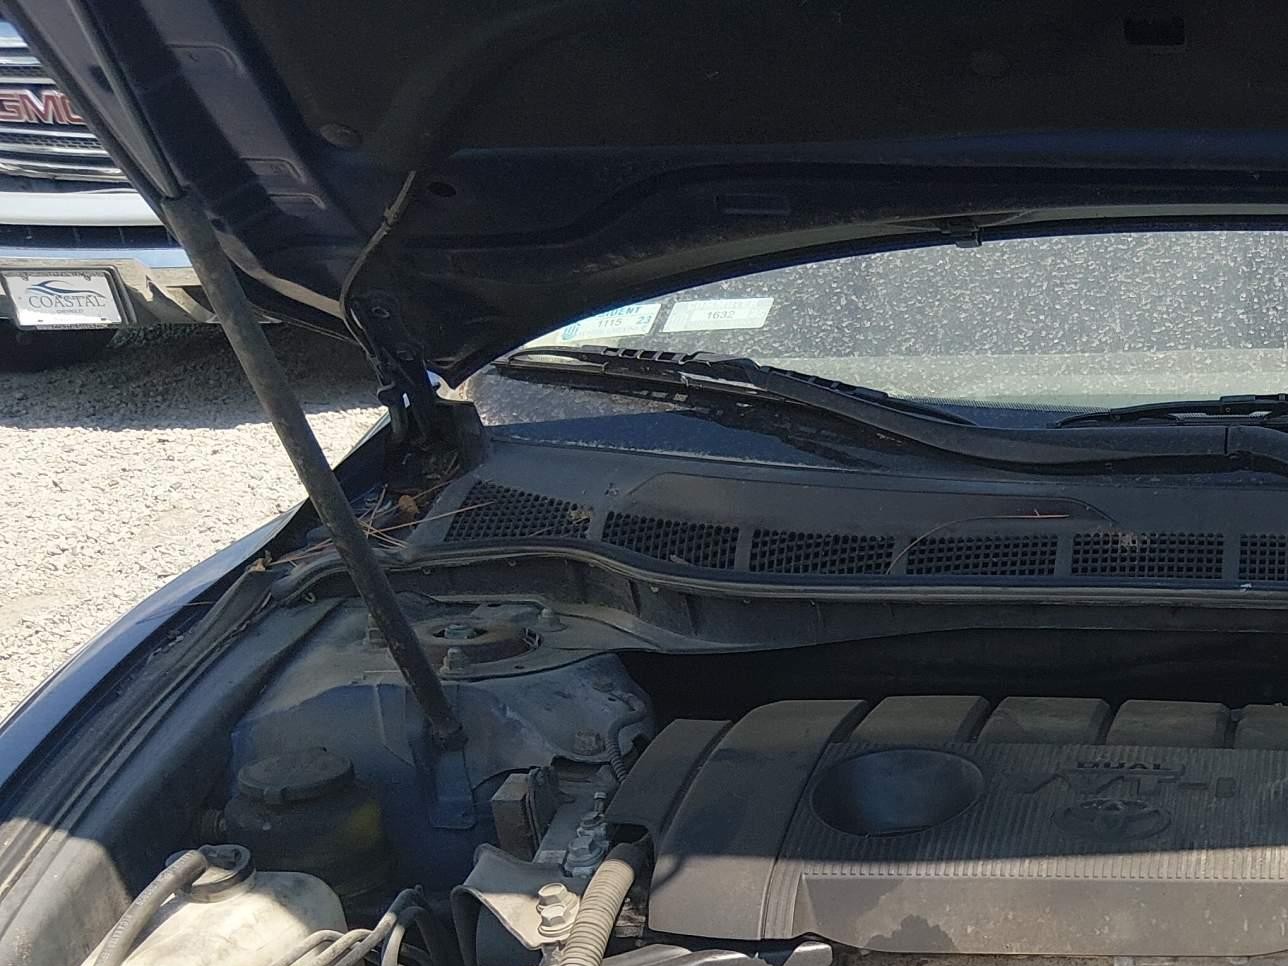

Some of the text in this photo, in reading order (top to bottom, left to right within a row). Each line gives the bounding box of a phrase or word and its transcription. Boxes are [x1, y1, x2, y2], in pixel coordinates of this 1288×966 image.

[28, 294, 106, 309] COASTAL
[706, 310, 736, 320] 1632
[598, 317, 624, 328] 1115
